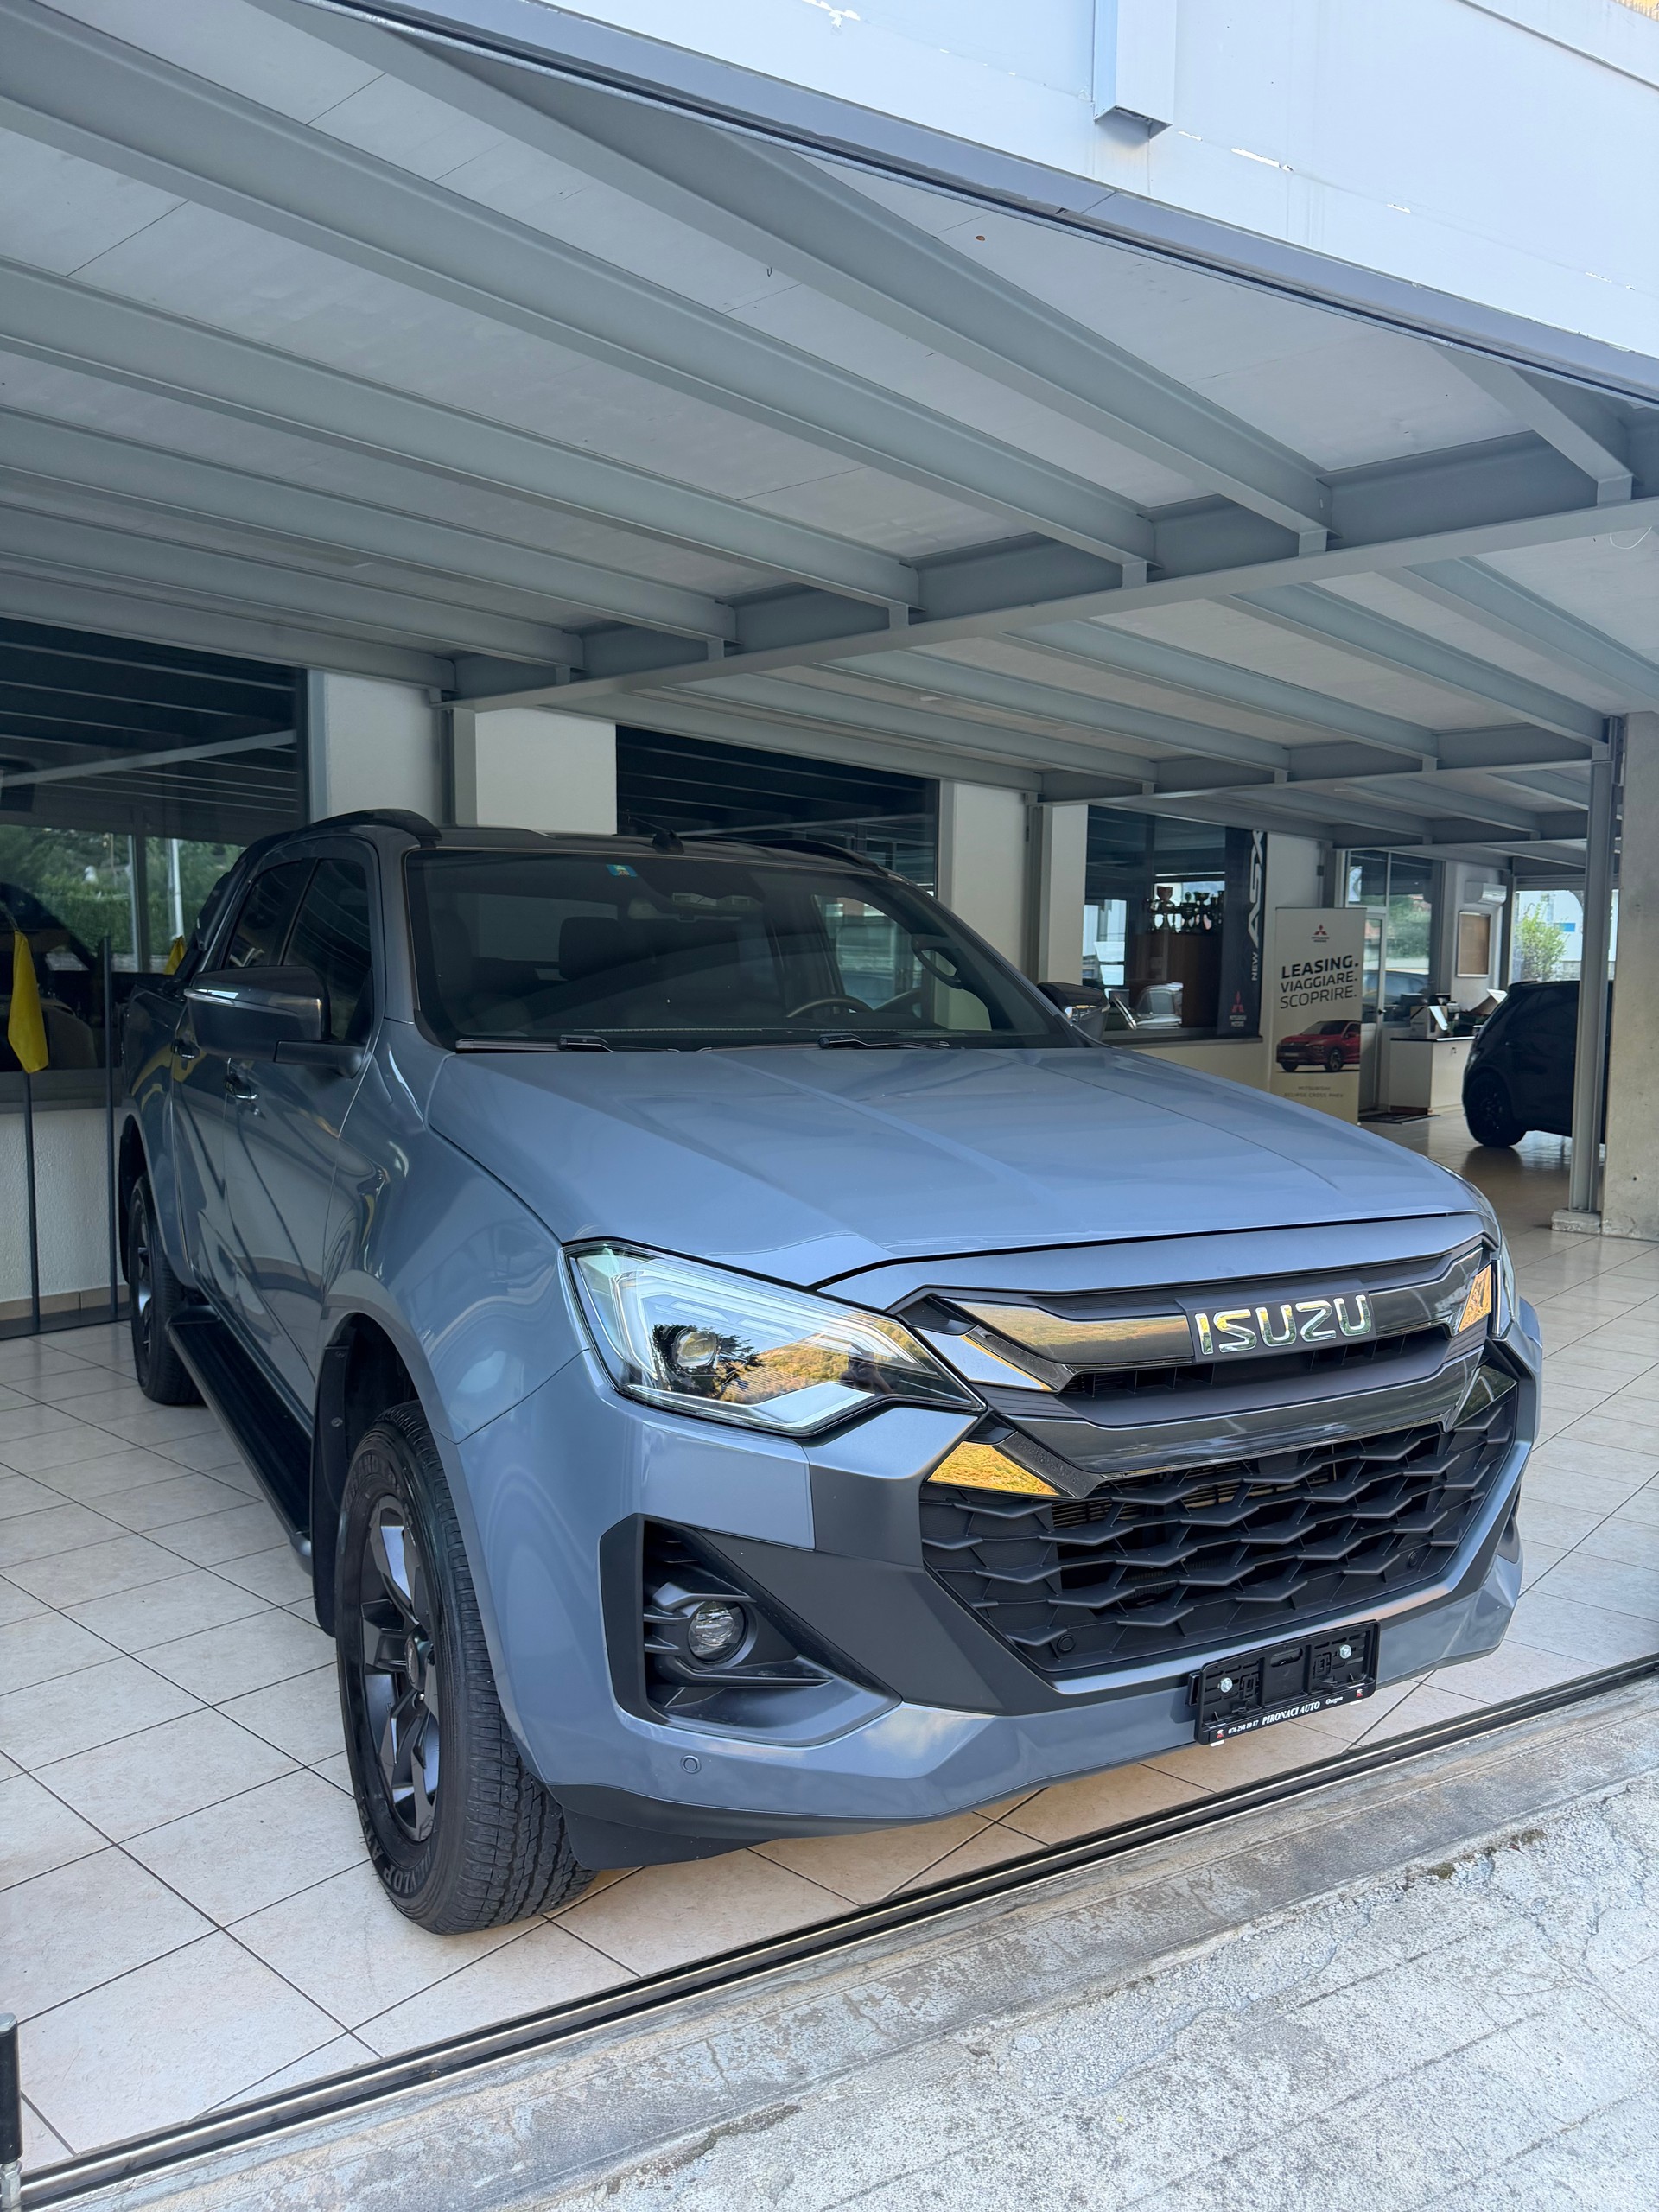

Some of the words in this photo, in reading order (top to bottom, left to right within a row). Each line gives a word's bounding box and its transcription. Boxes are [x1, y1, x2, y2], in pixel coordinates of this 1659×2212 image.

[1248, 830, 1264, 949] ASX
[1281, 955, 1359, 979] LEASING.
[1281, 971, 1357, 993] VIAGGIARE.
[1280, 985, 1357, 1009] SCOPRIRE.
[1194, 1294, 1372, 1356] ISUZU
[1262, 1707, 1299, 1726] PIRONACI
[1299, 1700, 1320, 1714] AUTO
